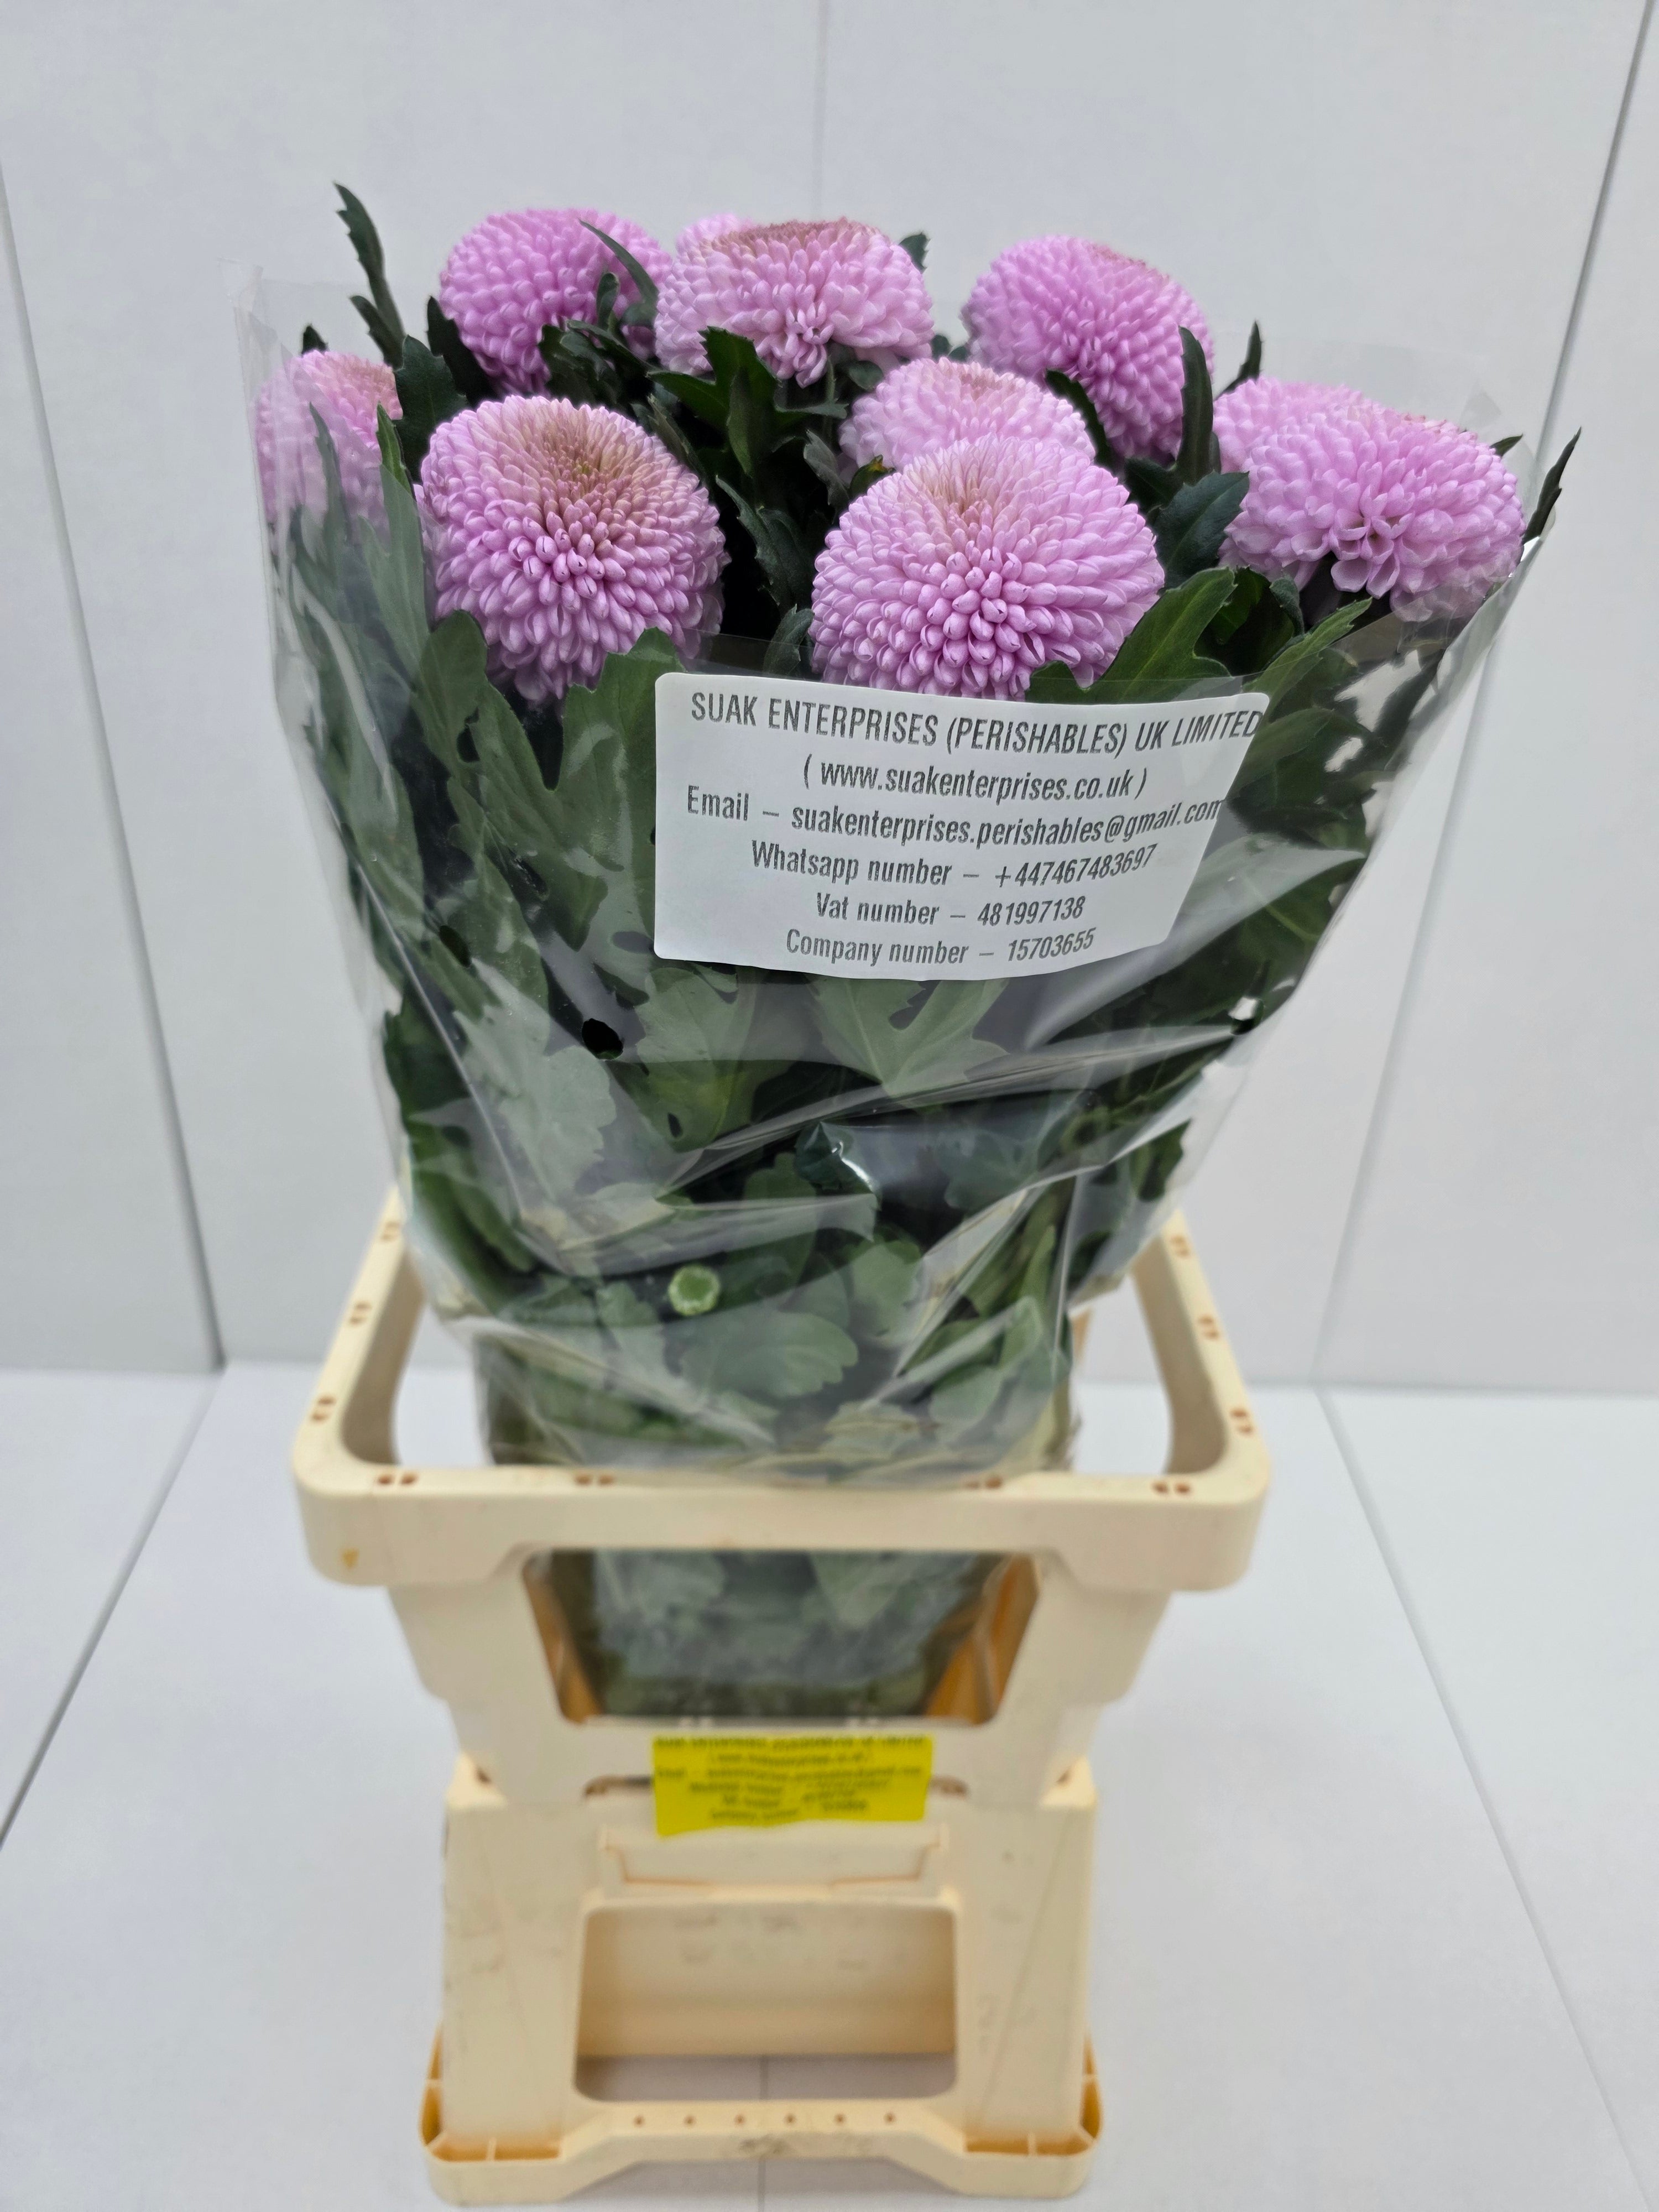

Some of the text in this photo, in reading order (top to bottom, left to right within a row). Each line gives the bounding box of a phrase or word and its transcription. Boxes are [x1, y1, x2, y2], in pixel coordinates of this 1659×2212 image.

[691, 692, 1263, 759] SUAK ENTERPRISES (PERISHABLES) UK LIMITED
[821, 762, 1134, 806] www.suakenterprises.co.uk
[687, 785, 749, 821] Email
[791, 800, 1222, 850] suakenterprises.perishables@gmail.com
[752, 839, 859, 885] Whatsapp
[867, 858, 952, 885] number
[995, 843, 1158, 888] +447467483697
[817, 892, 849, 920] Vat
[857, 899, 940, 925] number
[977, 895, 1086, 926] 481997138
[786, 928, 883, 967] Company
[889, 940, 969, 964] number
[1008, 927, 1097, 962] 15703655
